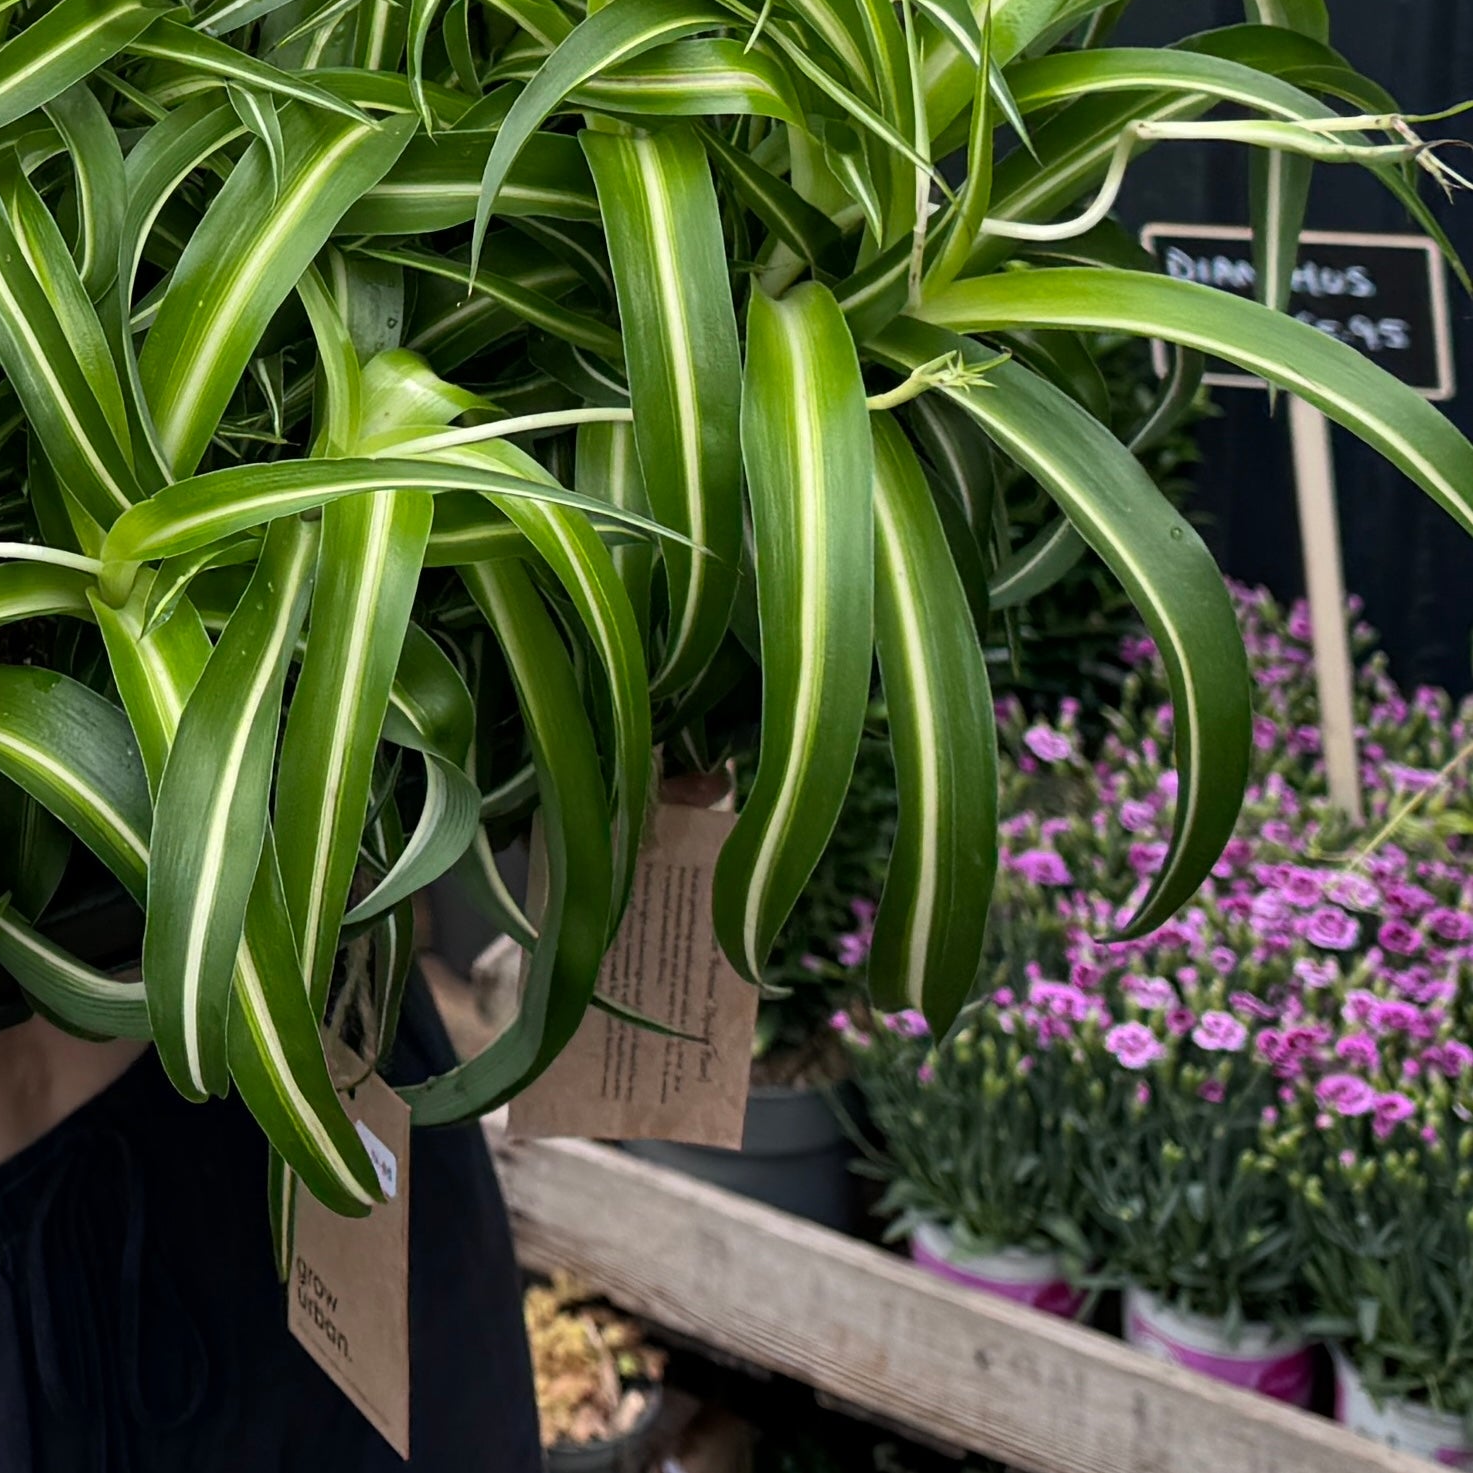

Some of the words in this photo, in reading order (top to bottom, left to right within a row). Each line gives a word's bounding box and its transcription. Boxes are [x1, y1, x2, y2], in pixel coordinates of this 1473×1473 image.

[1166, 246, 1377, 298] DIANHUS
[296, 1255, 338, 1312] grow
[297, 1284, 353, 1363] urban.
